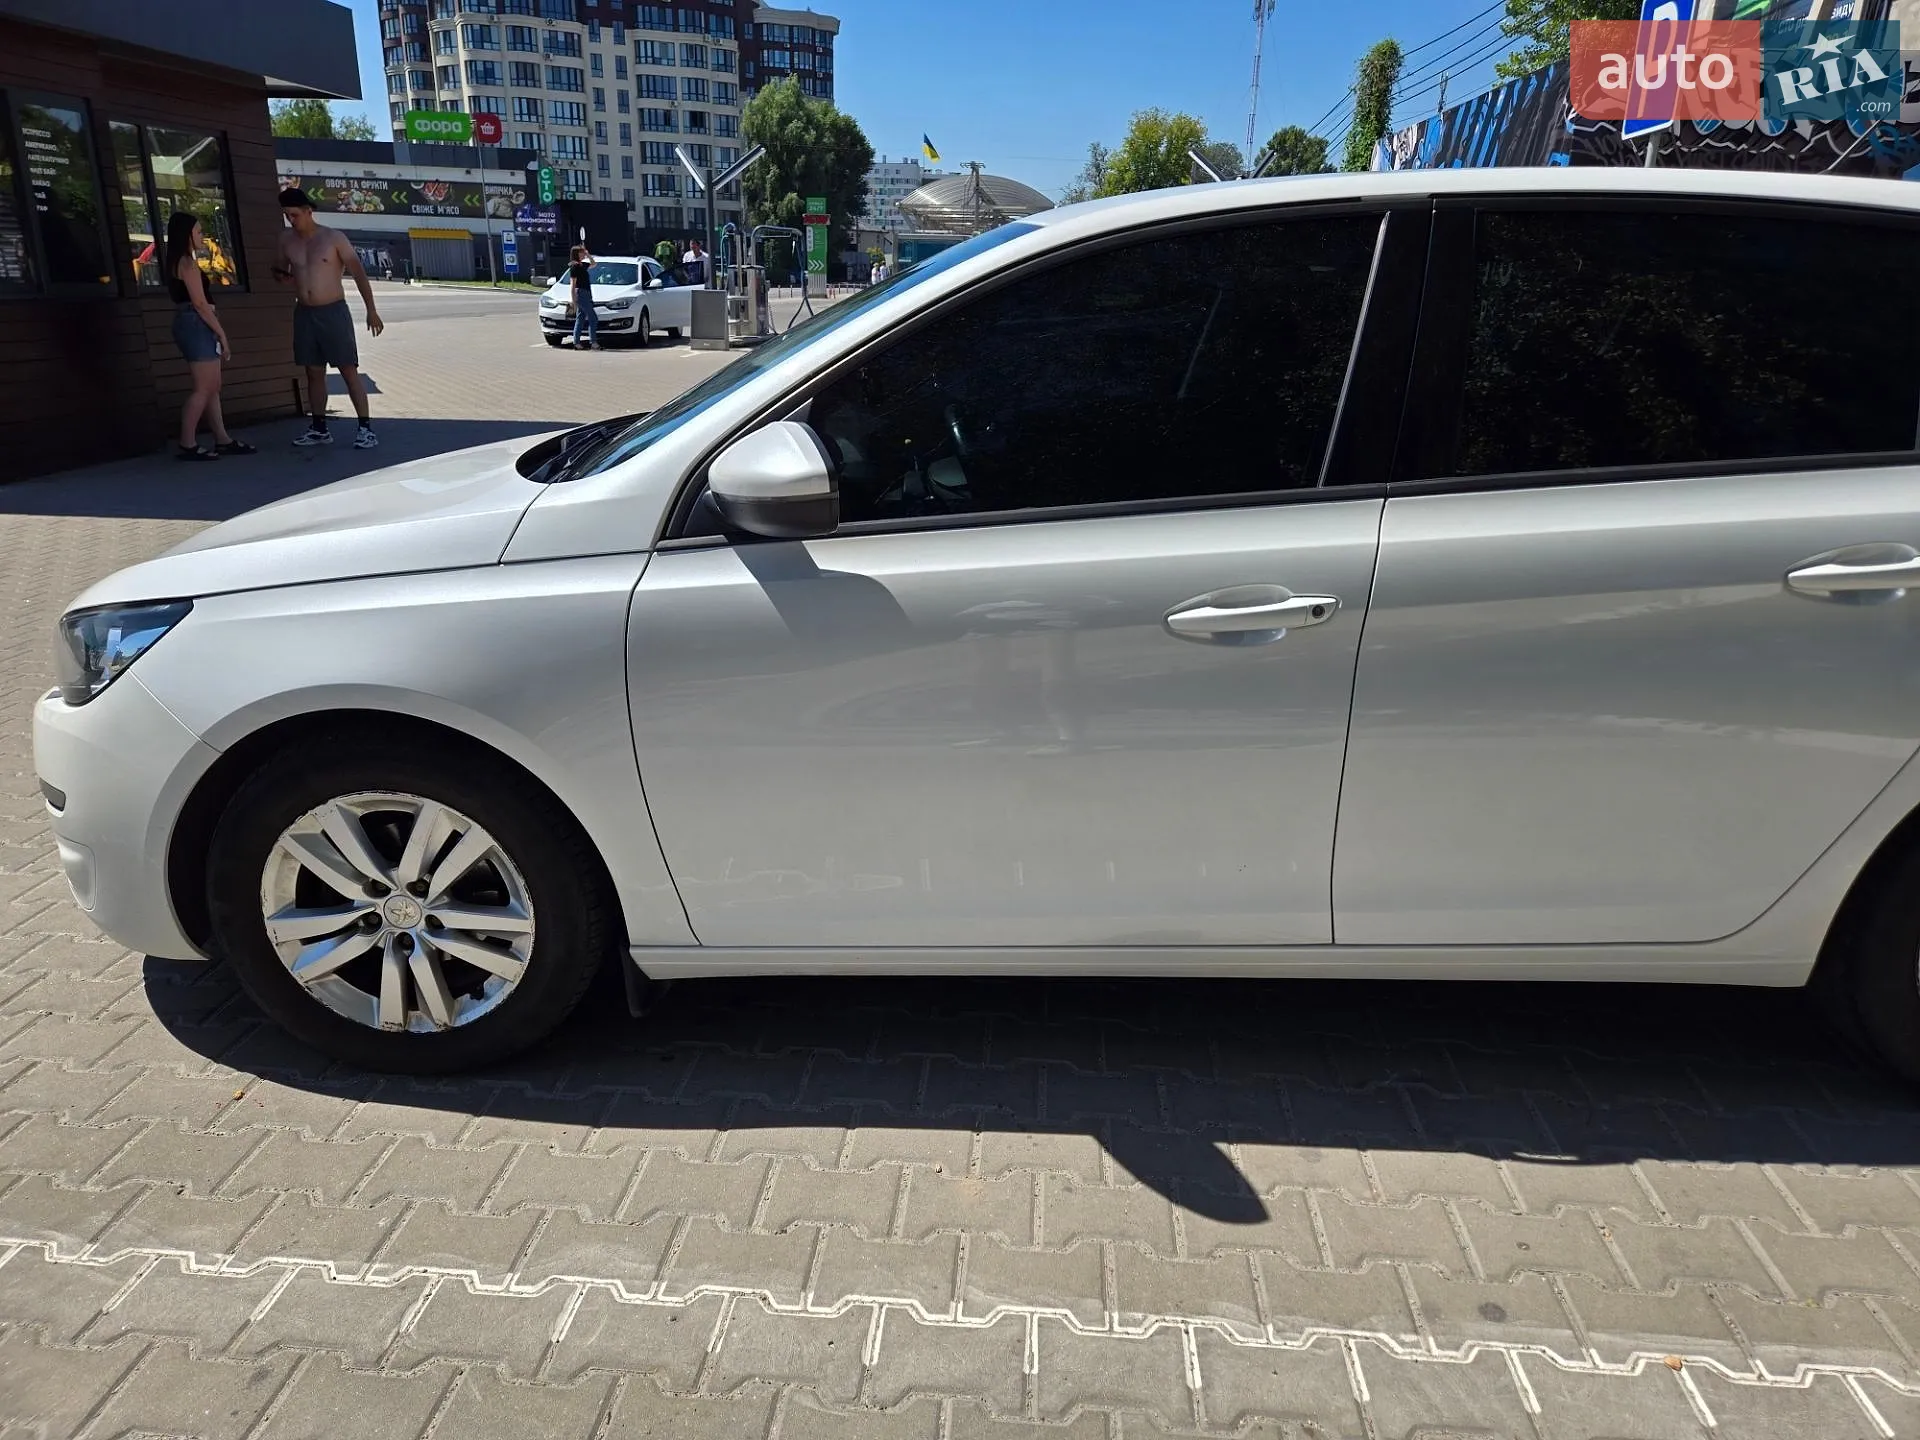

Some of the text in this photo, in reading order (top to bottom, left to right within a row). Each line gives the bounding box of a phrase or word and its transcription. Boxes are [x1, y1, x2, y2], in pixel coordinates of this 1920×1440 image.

[325, 178, 388, 191] ОВОЧІ ТА ФРУКТИ
[485, 185, 513, 195] ВИПІЧКА
[540, 168, 553, 203] СТО
[411, 204, 460, 215] СВІЖЕ М'ЯСО
